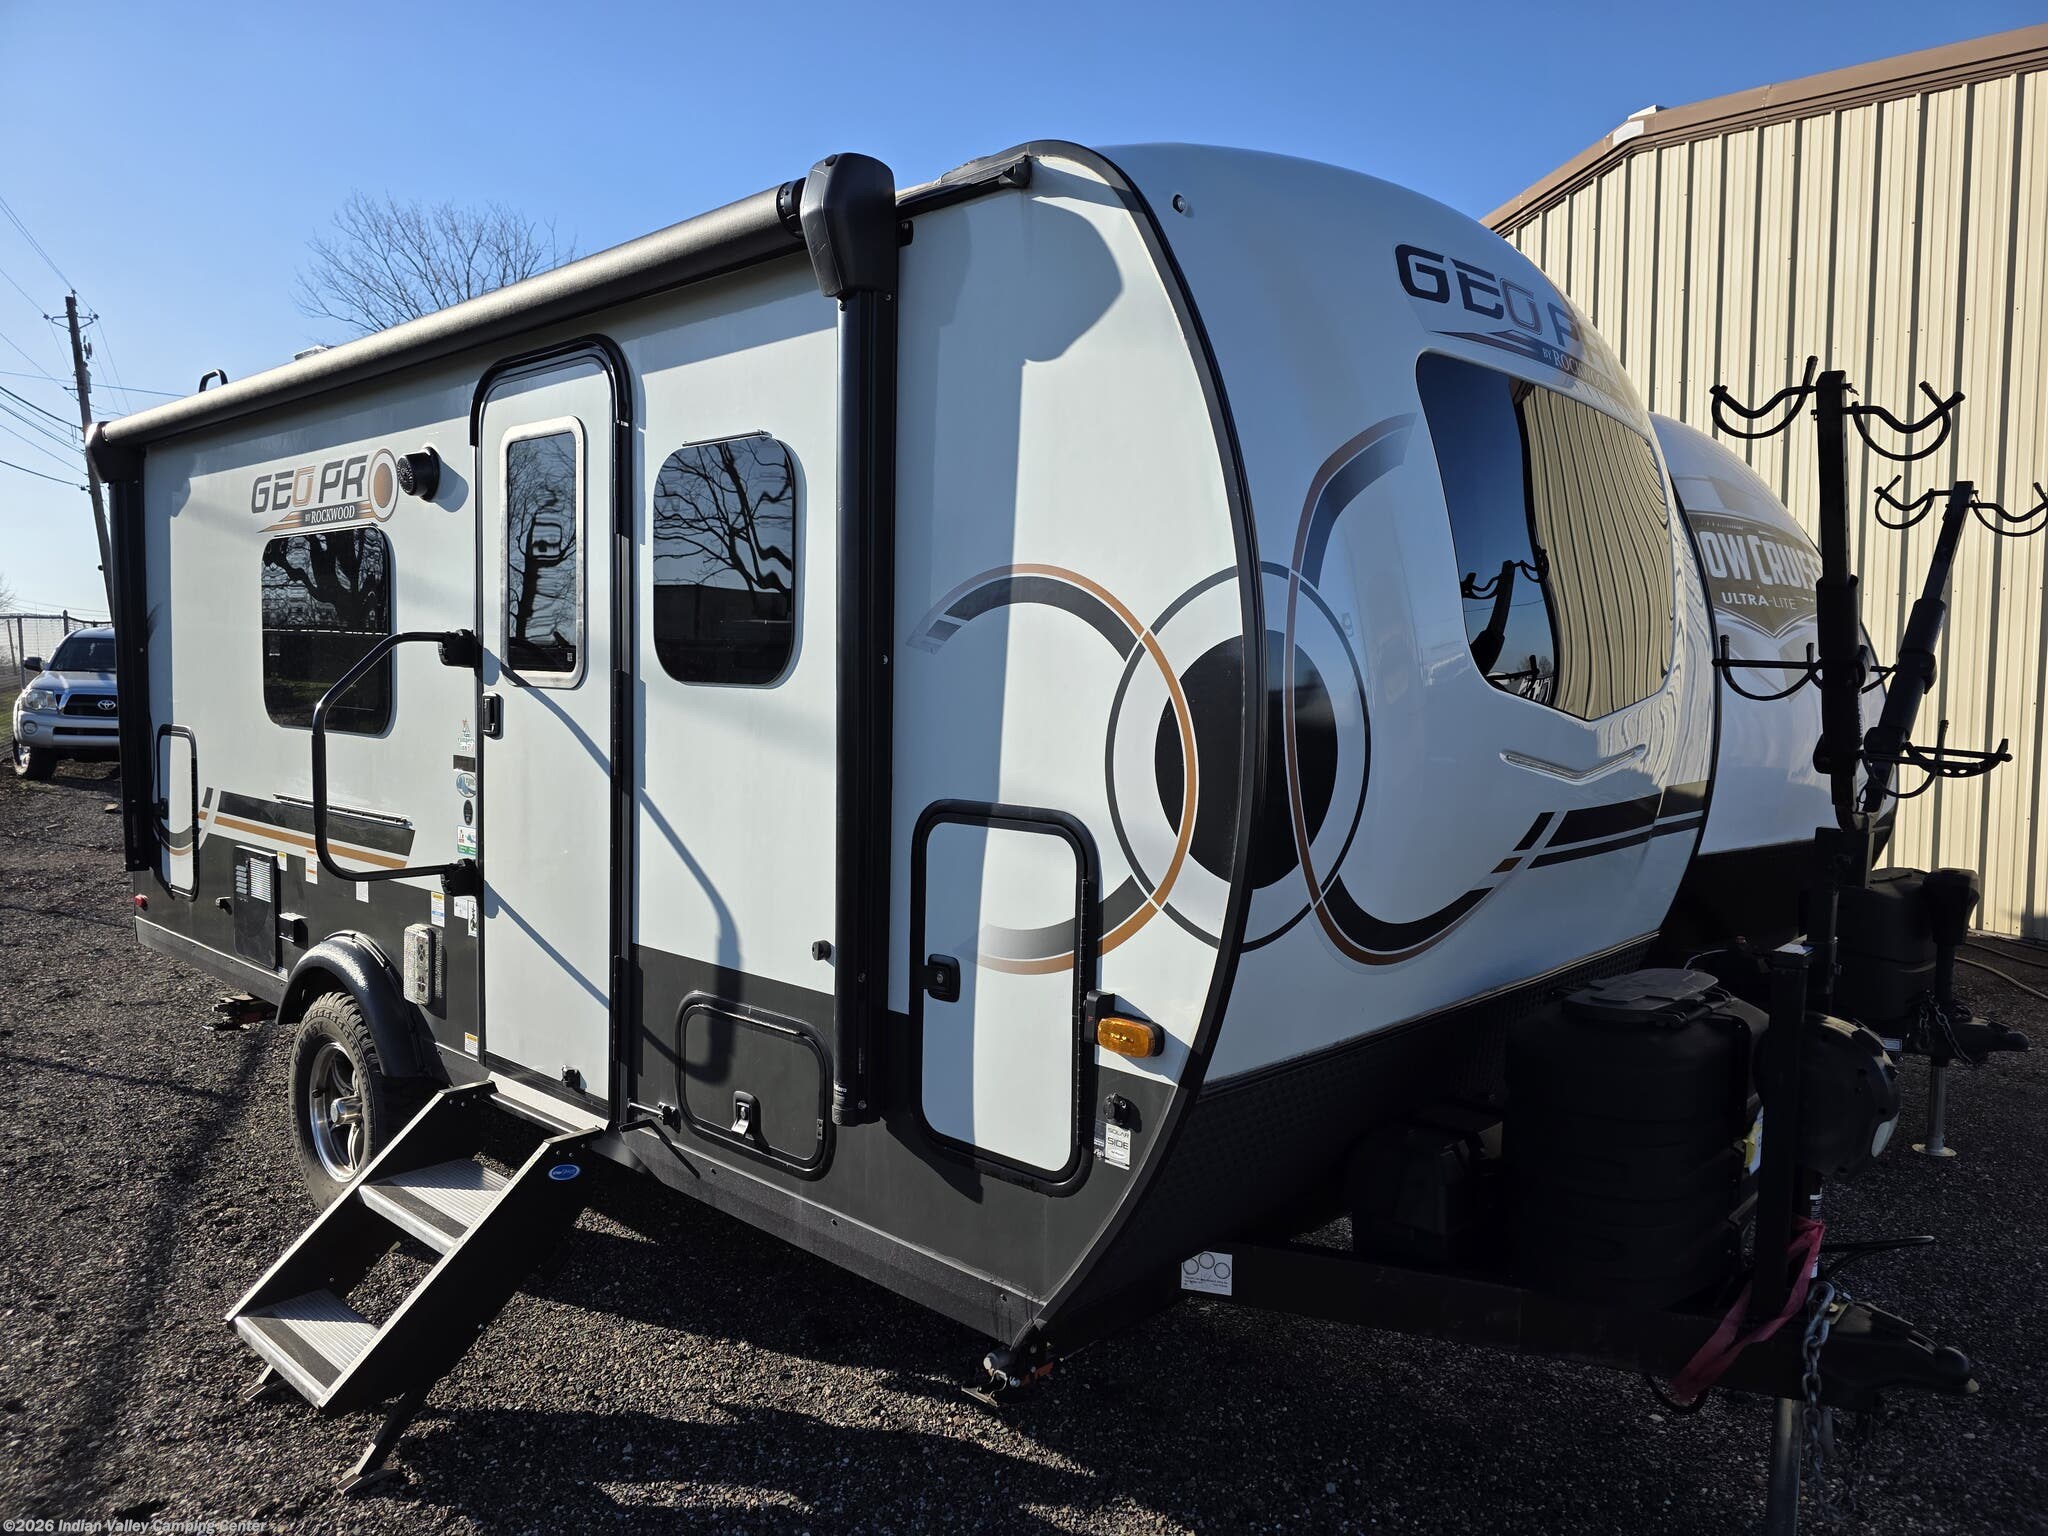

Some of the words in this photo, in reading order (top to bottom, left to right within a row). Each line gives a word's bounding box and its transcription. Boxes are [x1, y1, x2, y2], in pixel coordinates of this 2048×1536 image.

[1395, 244, 1543, 336] GEO
[250, 465, 316, 514] GEO
[311, 505, 355, 524] ROCKWOOD
[1694, 531, 1752, 581] OW
